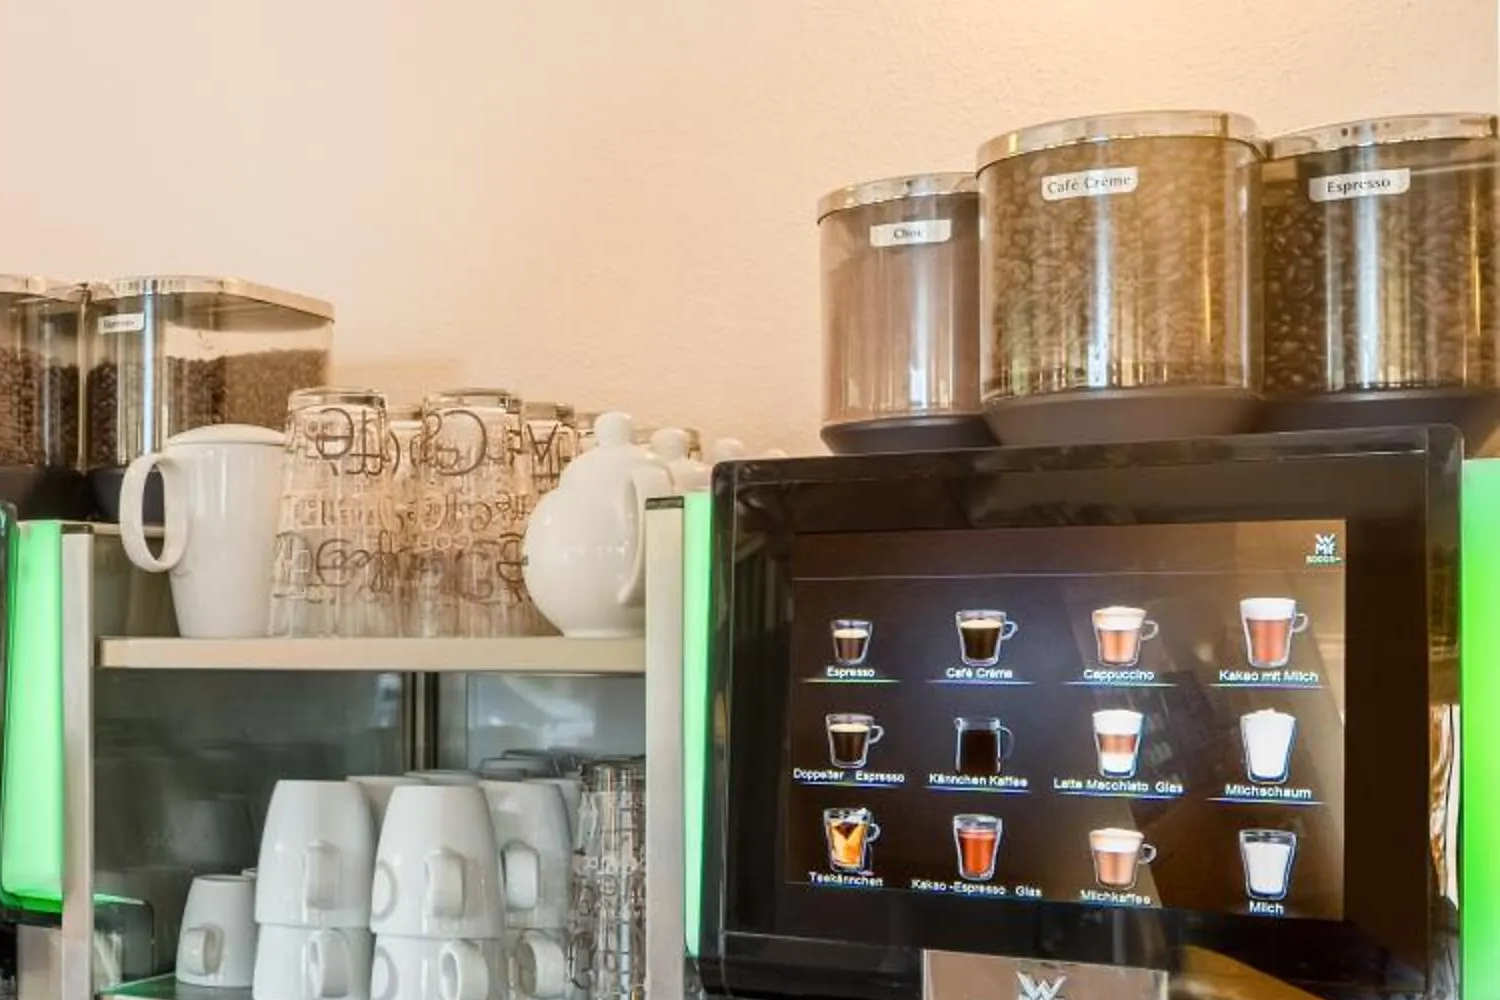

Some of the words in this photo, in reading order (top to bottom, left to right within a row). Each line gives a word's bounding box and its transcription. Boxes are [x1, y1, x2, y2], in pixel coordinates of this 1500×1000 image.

[1327, 179, 1391, 196] Espresso
[827, 667, 875, 679] Espresso
[1083, 669, 1155, 682] Cappuccino
[1219, 670, 1259, 682] Kakao
[855, 770, 905, 784] Espresso
[1053, 777, 1083, 791] Latte
[1225, 783, 1312, 798] Milchschaum
[1250, 900, 1284, 915] Milch
